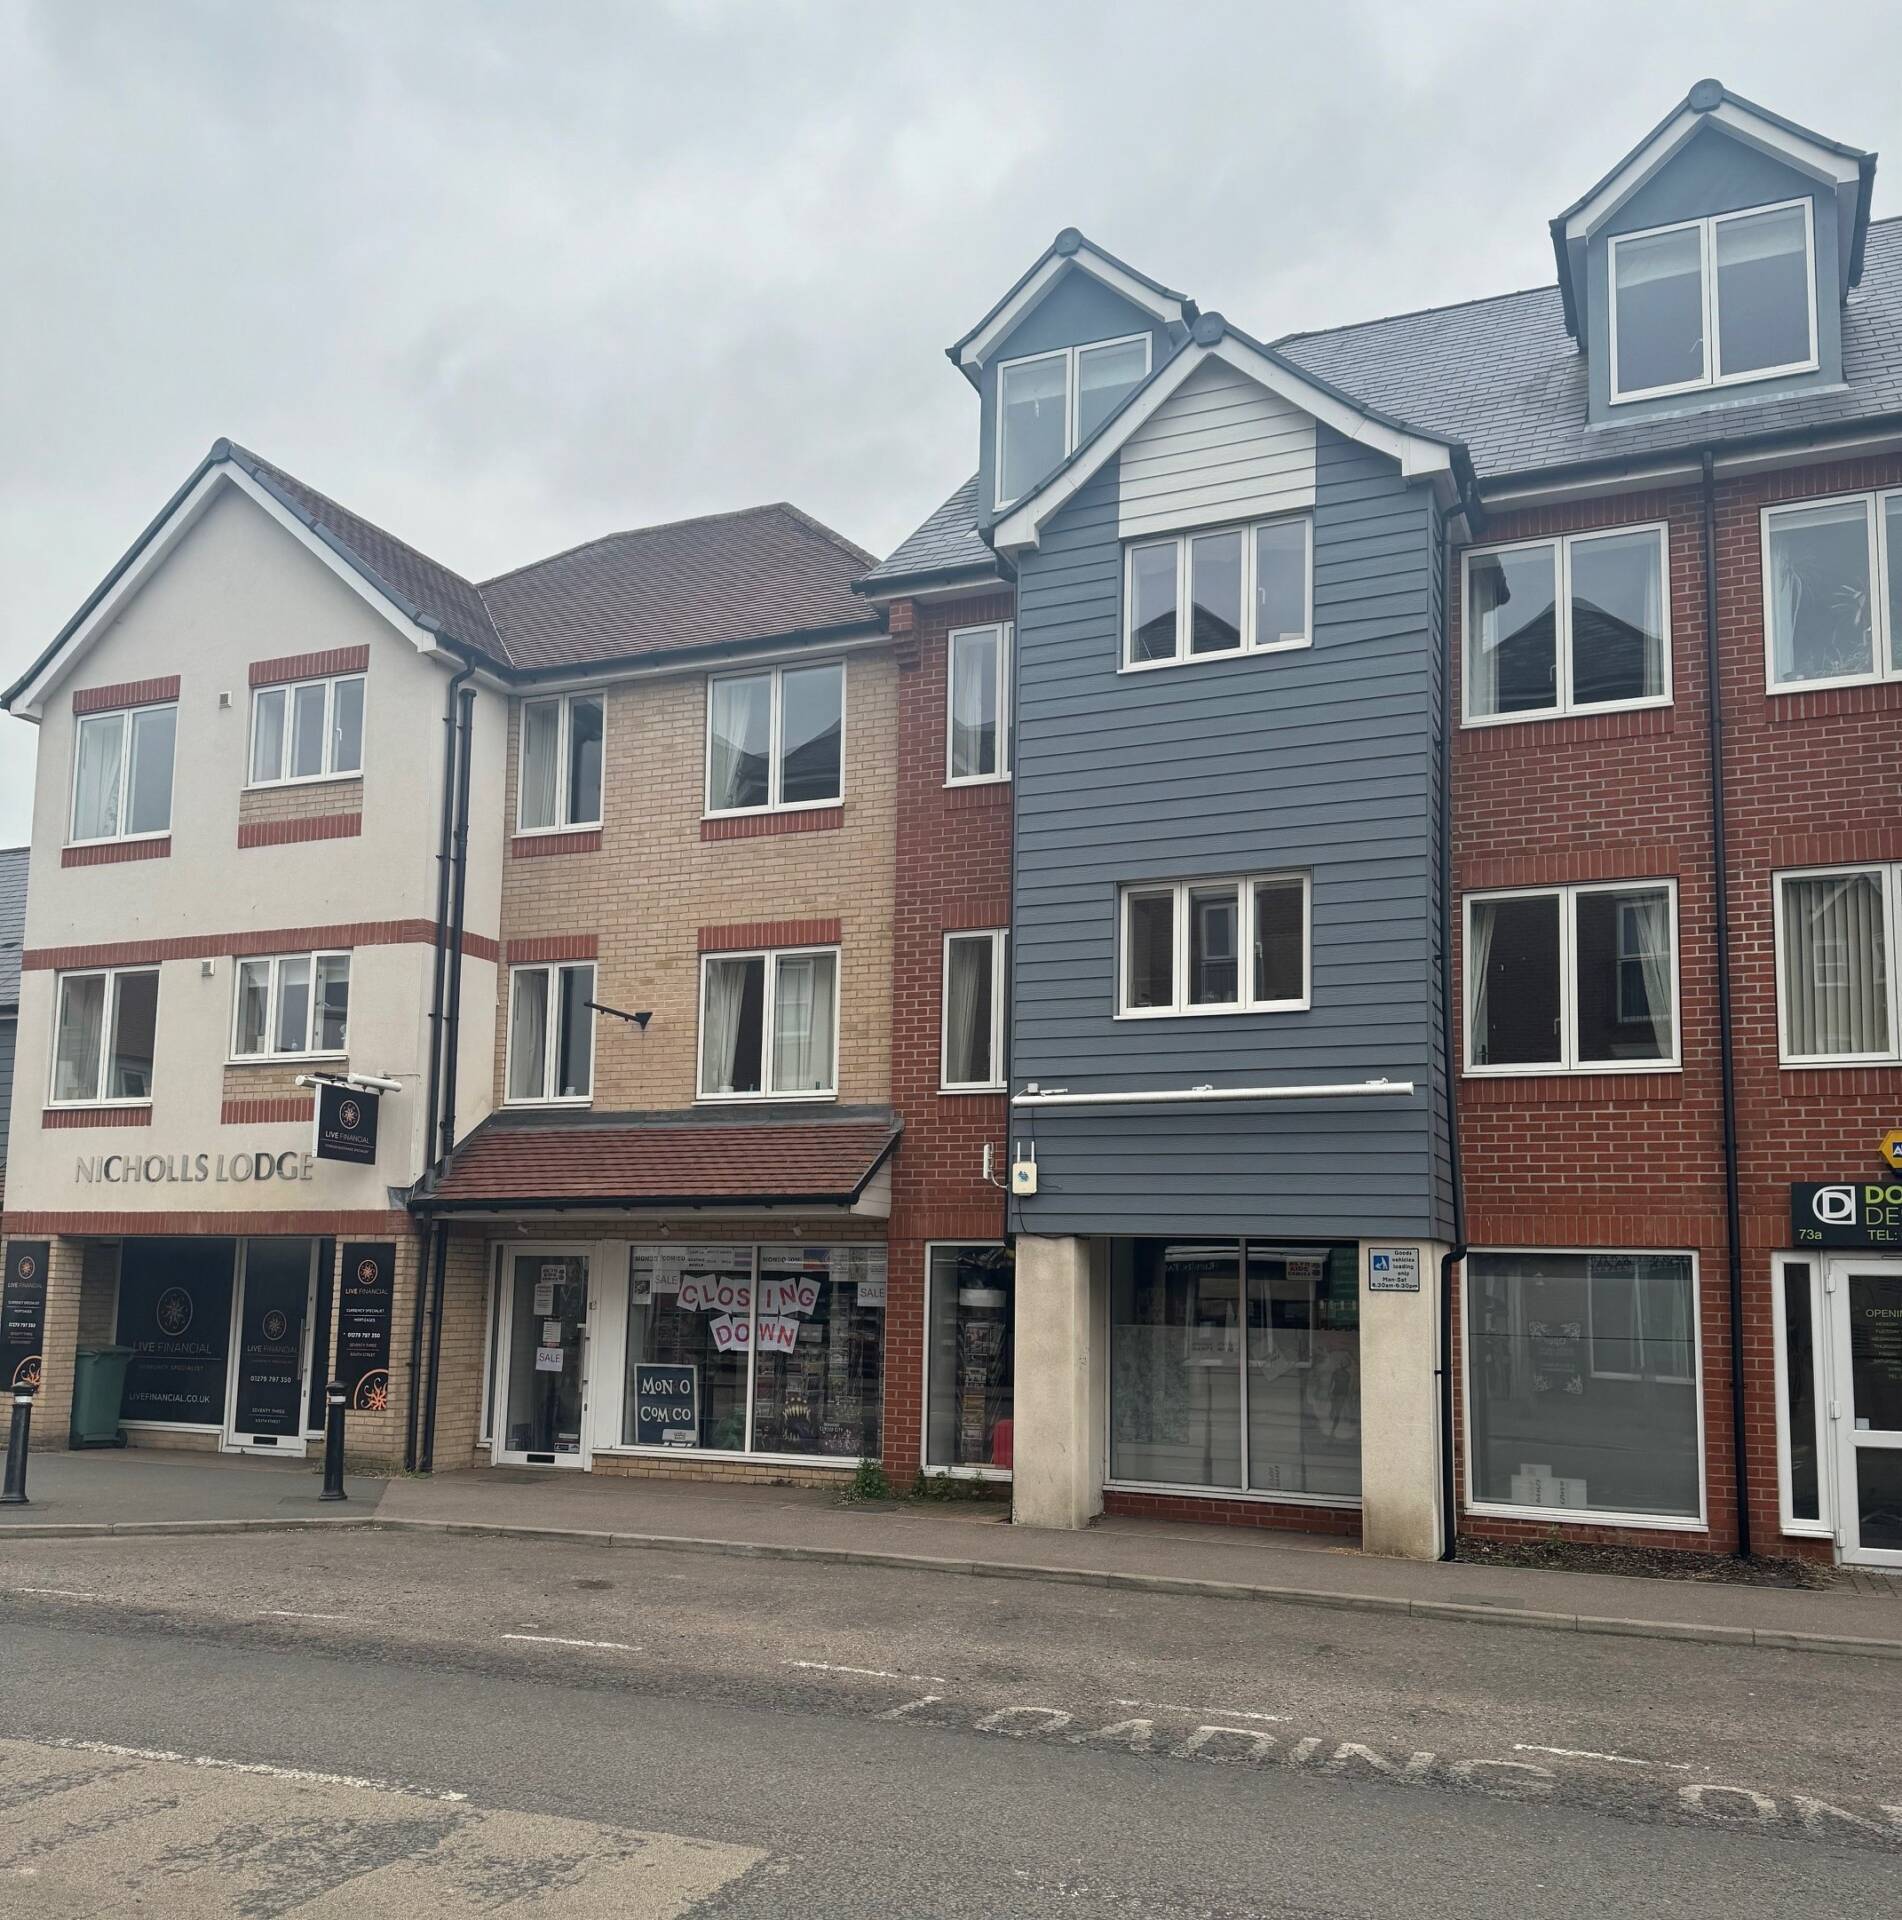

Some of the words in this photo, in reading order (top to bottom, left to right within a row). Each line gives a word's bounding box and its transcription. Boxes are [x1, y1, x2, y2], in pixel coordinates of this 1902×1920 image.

[325, 1130, 339, 1139] LIVE
[340, 1133, 370, 1144] FINANCIAL
[75, 1153, 209, 1183] NICHOLLS
[216, 1151, 314, 1182] LODGE
[1866, 1207, 1902, 1225] DE
[1798, 1229, 1823, 1240] 73a
[1867, 1229, 1898, 1241] TEL:
[655, 1275, 679, 1285] SALE
[682, 1284, 815, 1307] CLOSING
[860, 1287, 885, 1298] SALE
[715, 1323, 794, 1347] DOWN
[133, 1341, 155, 1353] LIVE
[157, 1342, 212, 1354] FINANCIAL
[247, 1345, 262, 1353] LIVE
[539, 1352, 561, 1363] SALE
[129, 1392, 210, 1403] LIVEFINANCIAL.CO.UK
[672, 1407, 691, 1421] CO
